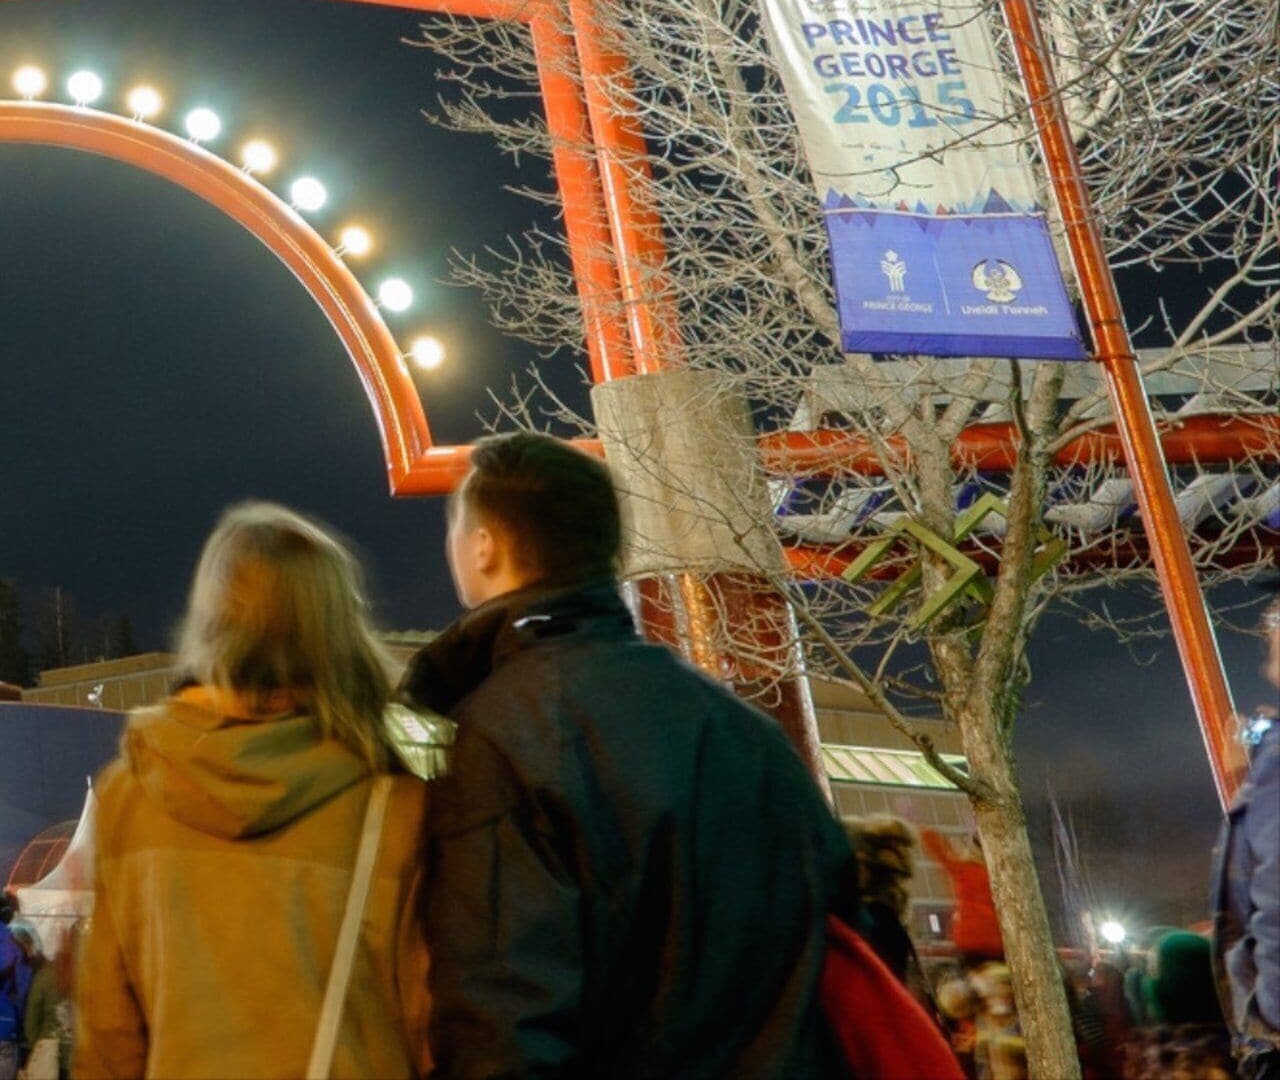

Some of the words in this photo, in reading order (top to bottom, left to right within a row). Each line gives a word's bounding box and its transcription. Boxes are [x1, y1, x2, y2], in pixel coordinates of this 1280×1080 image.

[801, 12, 951, 49] PRINCE
[813, 47, 961, 79] GEORGE
[824, 81, 977, 128] 2015
